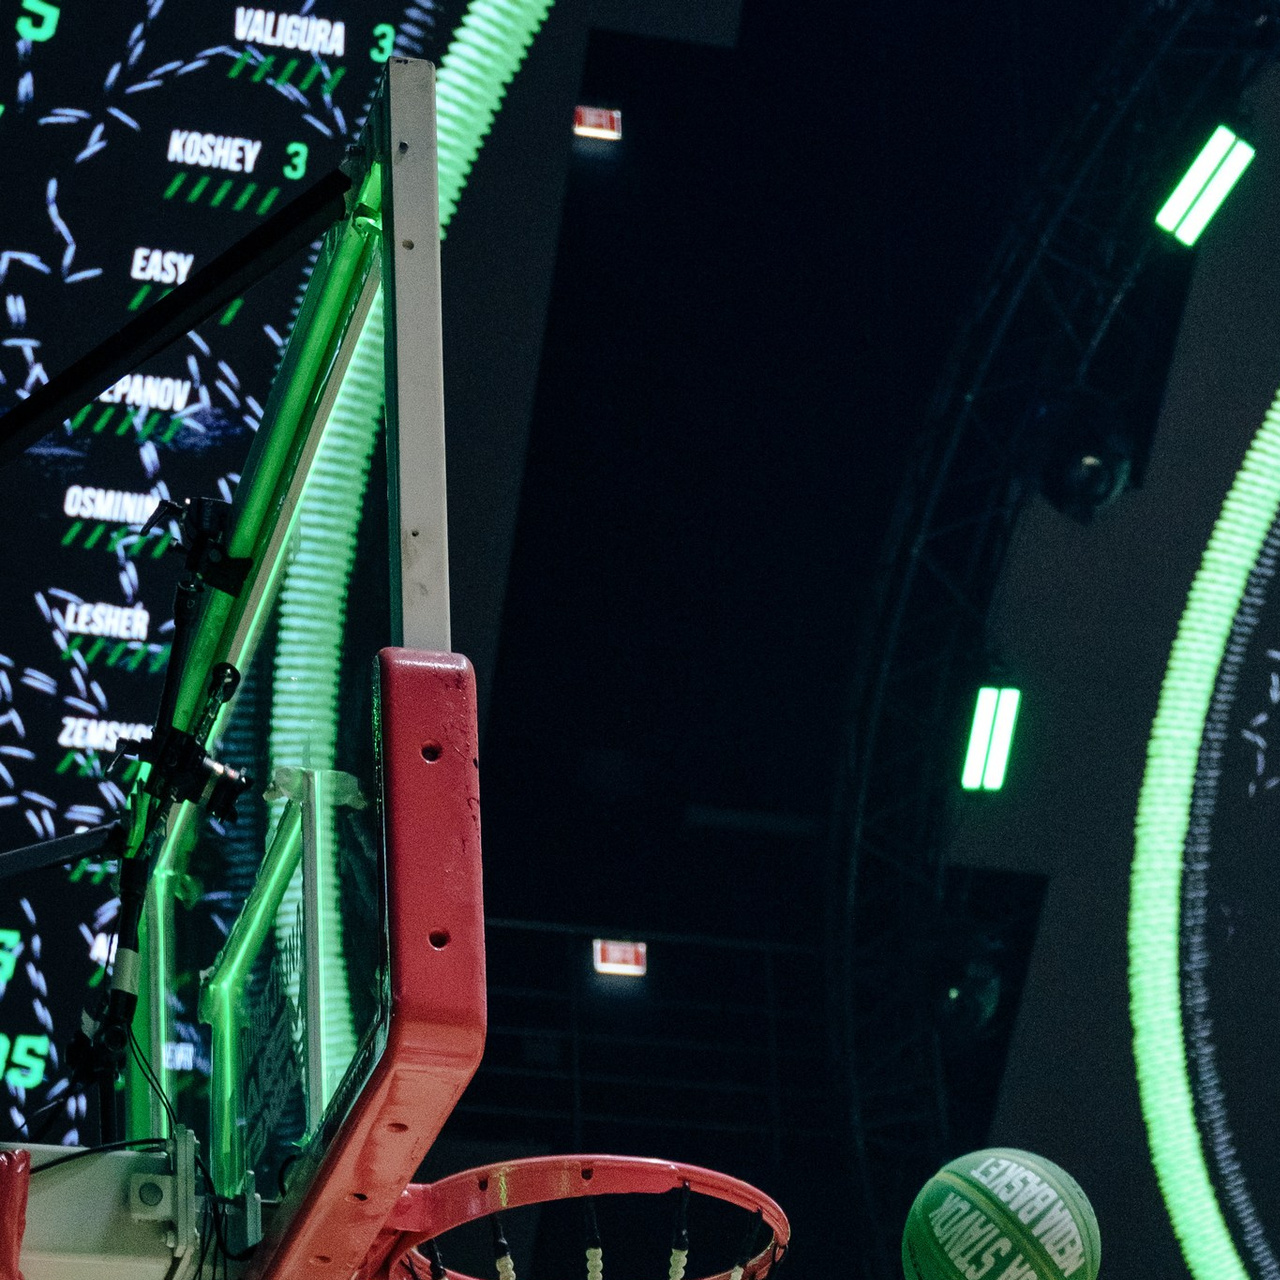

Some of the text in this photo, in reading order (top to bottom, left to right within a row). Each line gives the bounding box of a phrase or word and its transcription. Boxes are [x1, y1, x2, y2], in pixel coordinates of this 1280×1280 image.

[234, 6, 396, 63] VALIGURA 3
[167, 129, 309, 180] KOSHEY 3
[130, 247, 195, 284] EASY
[64, 602, 150, 641] LESHER
[970, 1157, 1086, 1278] MEDIA BASKET
